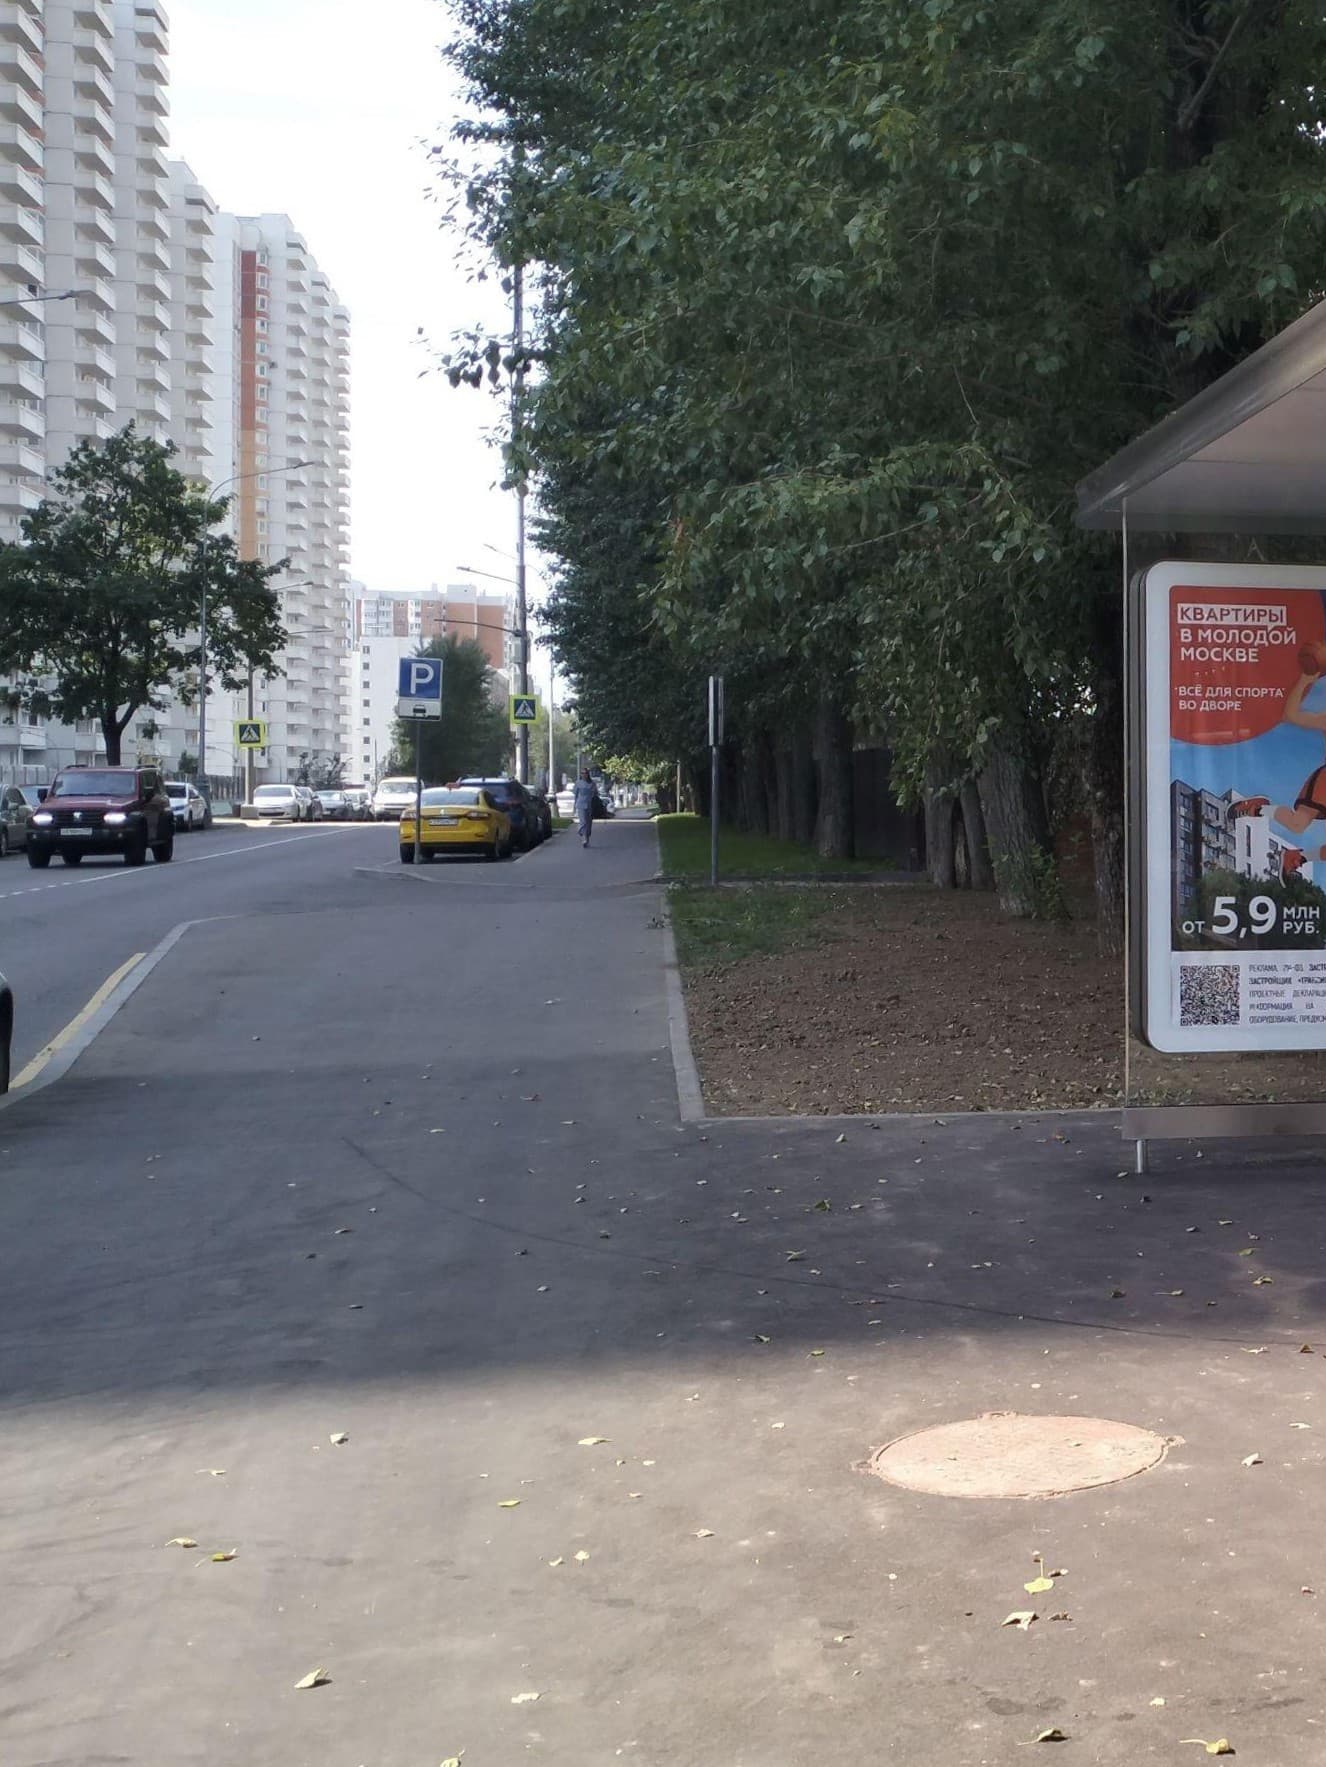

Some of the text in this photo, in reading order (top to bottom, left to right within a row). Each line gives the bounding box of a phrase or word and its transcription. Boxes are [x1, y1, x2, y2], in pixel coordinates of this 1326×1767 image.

[1179, 606, 1285, 624] КВАРТИРЫ
[1180, 625, 1297, 646] В МОЛОДОЙ
[1180, 647, 1260, 663] МОСКВЕ
[410, 663, 435, 695] P
[1178, 684, 1203, 697] ВСЁ
[1205, 686, 1233, 698] ДЛЯ
[1178, 700, 1243, 712] ВО ДВОРЕ
[1182, 894, 1321, 940] ОТ 5,9 МЛН
[1283, 920, 1321, 935] РУБ.
